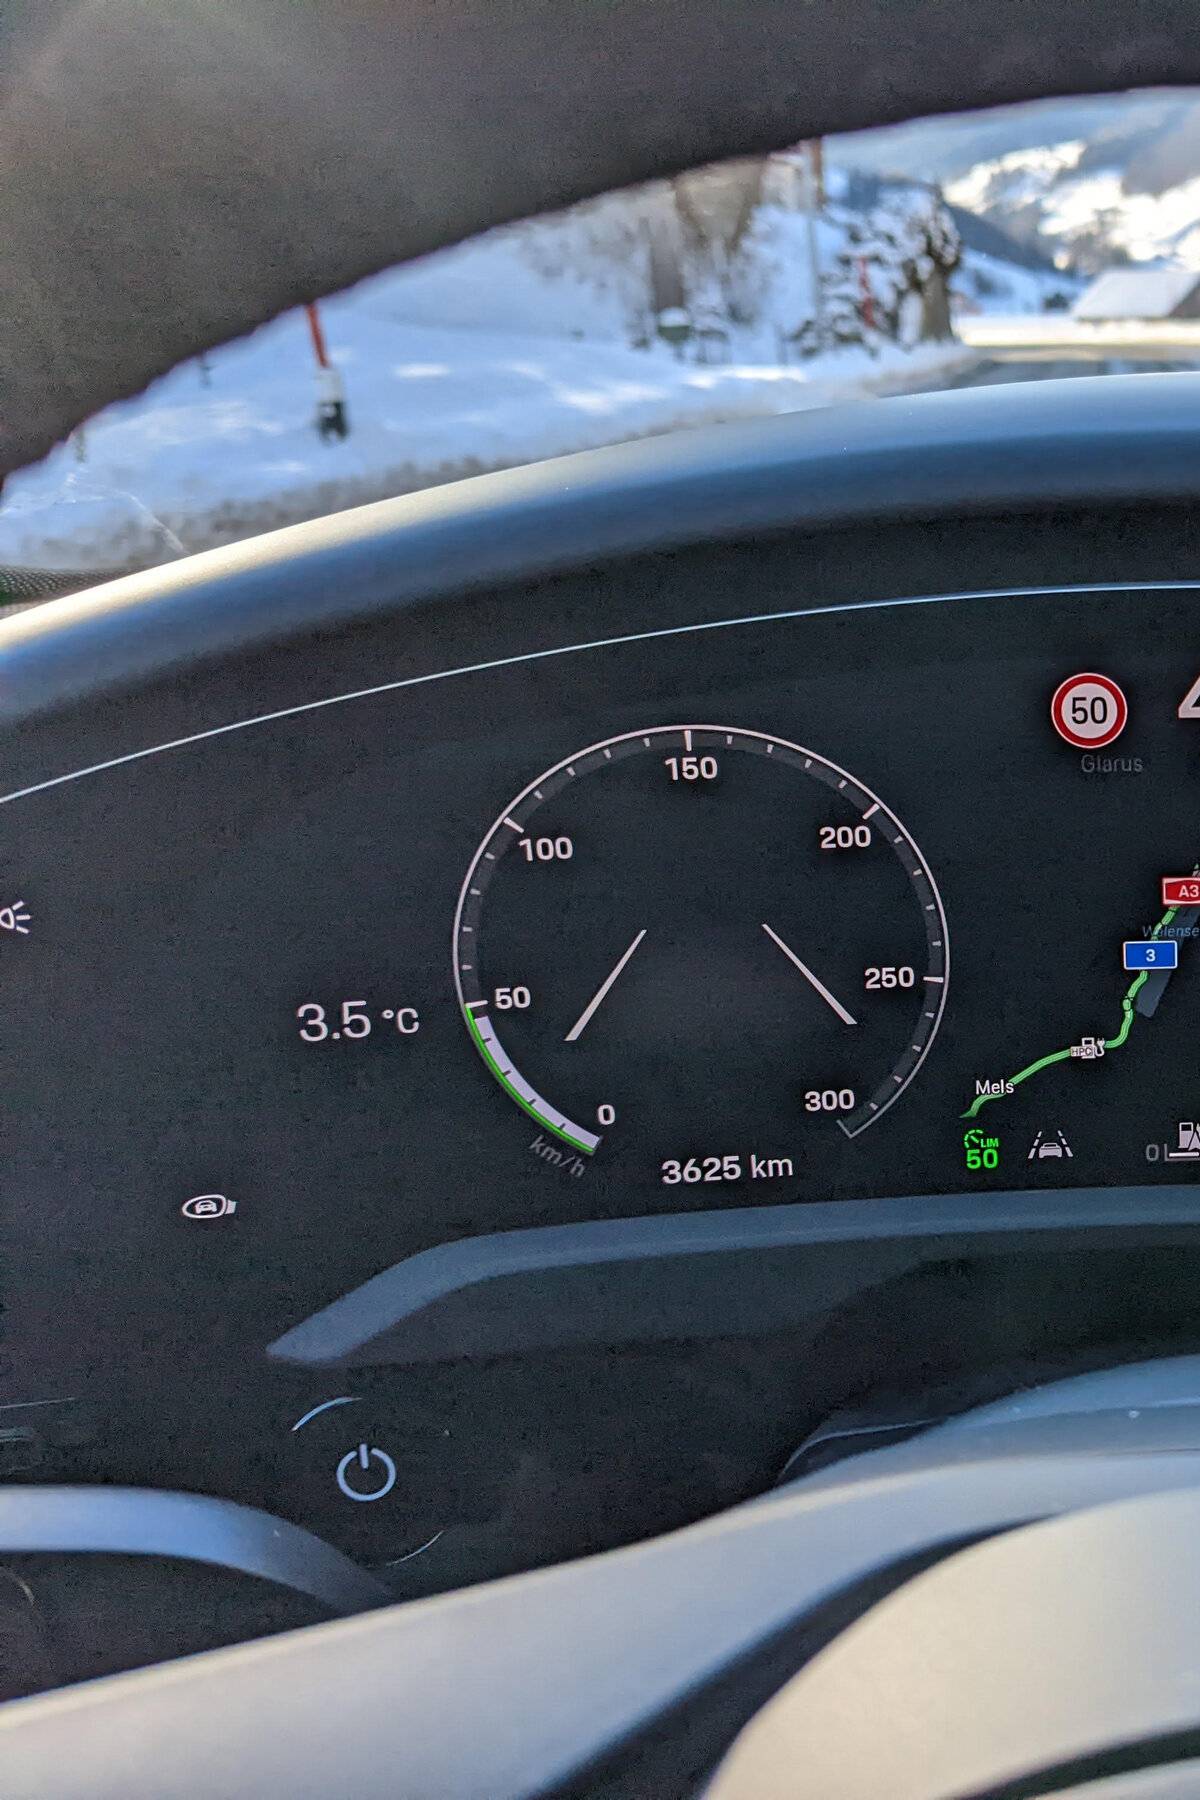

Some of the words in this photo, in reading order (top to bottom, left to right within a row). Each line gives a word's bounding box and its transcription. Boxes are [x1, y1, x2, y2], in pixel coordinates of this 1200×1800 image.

[1071, 696, 1108, 725] 50
[666, 757, 719, 782] 150
[1081, 754, 1144, 773] Glarus
[819, 825, 872, 850] 200
[519, 837, 574, 863] 100
[1178, 885, 1199, 898] A3
[1145, 949, 1156, 962] 3
[864, 966, 916, 990] 250
[495, 987, 532, 1011] 50
[298, 1001, 372, 1042] 3.5
[382, 1008, 421, 1035] °C
[975, 1079, 1015, 1095] Mels
[804, 1089, 857, 1113] 300
[597, 1104, 617, 1127] 0
[980, 1138, 999, 1148] LIM
[1145, 1144, 1160, 1162] 0
[529, 1134, 586, 1177] km/h
[966, 1149, 999, 1169] 50
[661, 1158, 743, 1185] 3625
[750, 1154, 794, 1179] km
